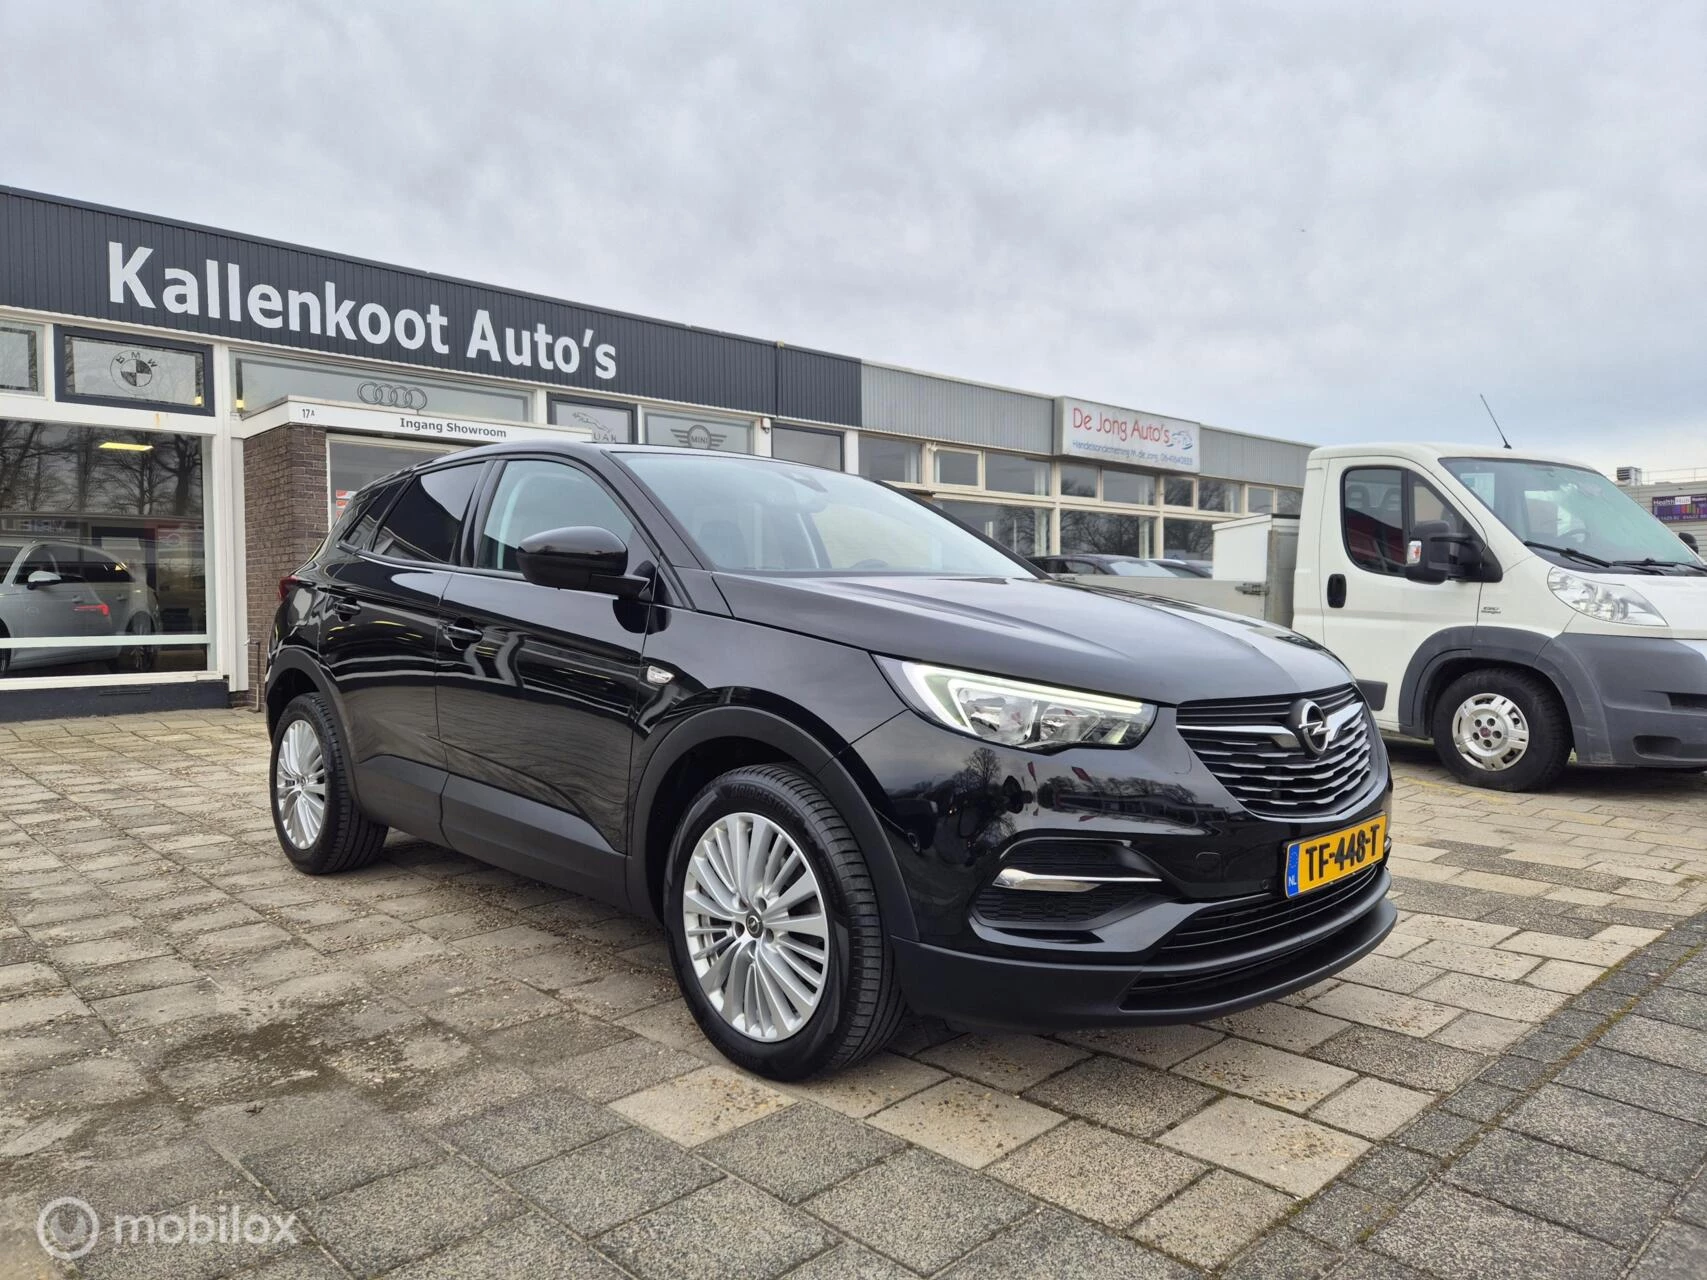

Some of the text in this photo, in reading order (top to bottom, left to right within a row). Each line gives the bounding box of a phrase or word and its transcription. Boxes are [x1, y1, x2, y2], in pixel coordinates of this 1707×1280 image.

[108, 242, 617, 380] Kallenkoot Auto's
[116, 351, 158, 367] BMW
[400, 417, 507, 438] Ingang Showroom
[1073, 408, 1170, 443] De Jong Auto's
[690, 434, 708, 445] MINI
[1306, 824, 1380, 881] TF-448-T
[1288, 874, 1297, 886] NL
